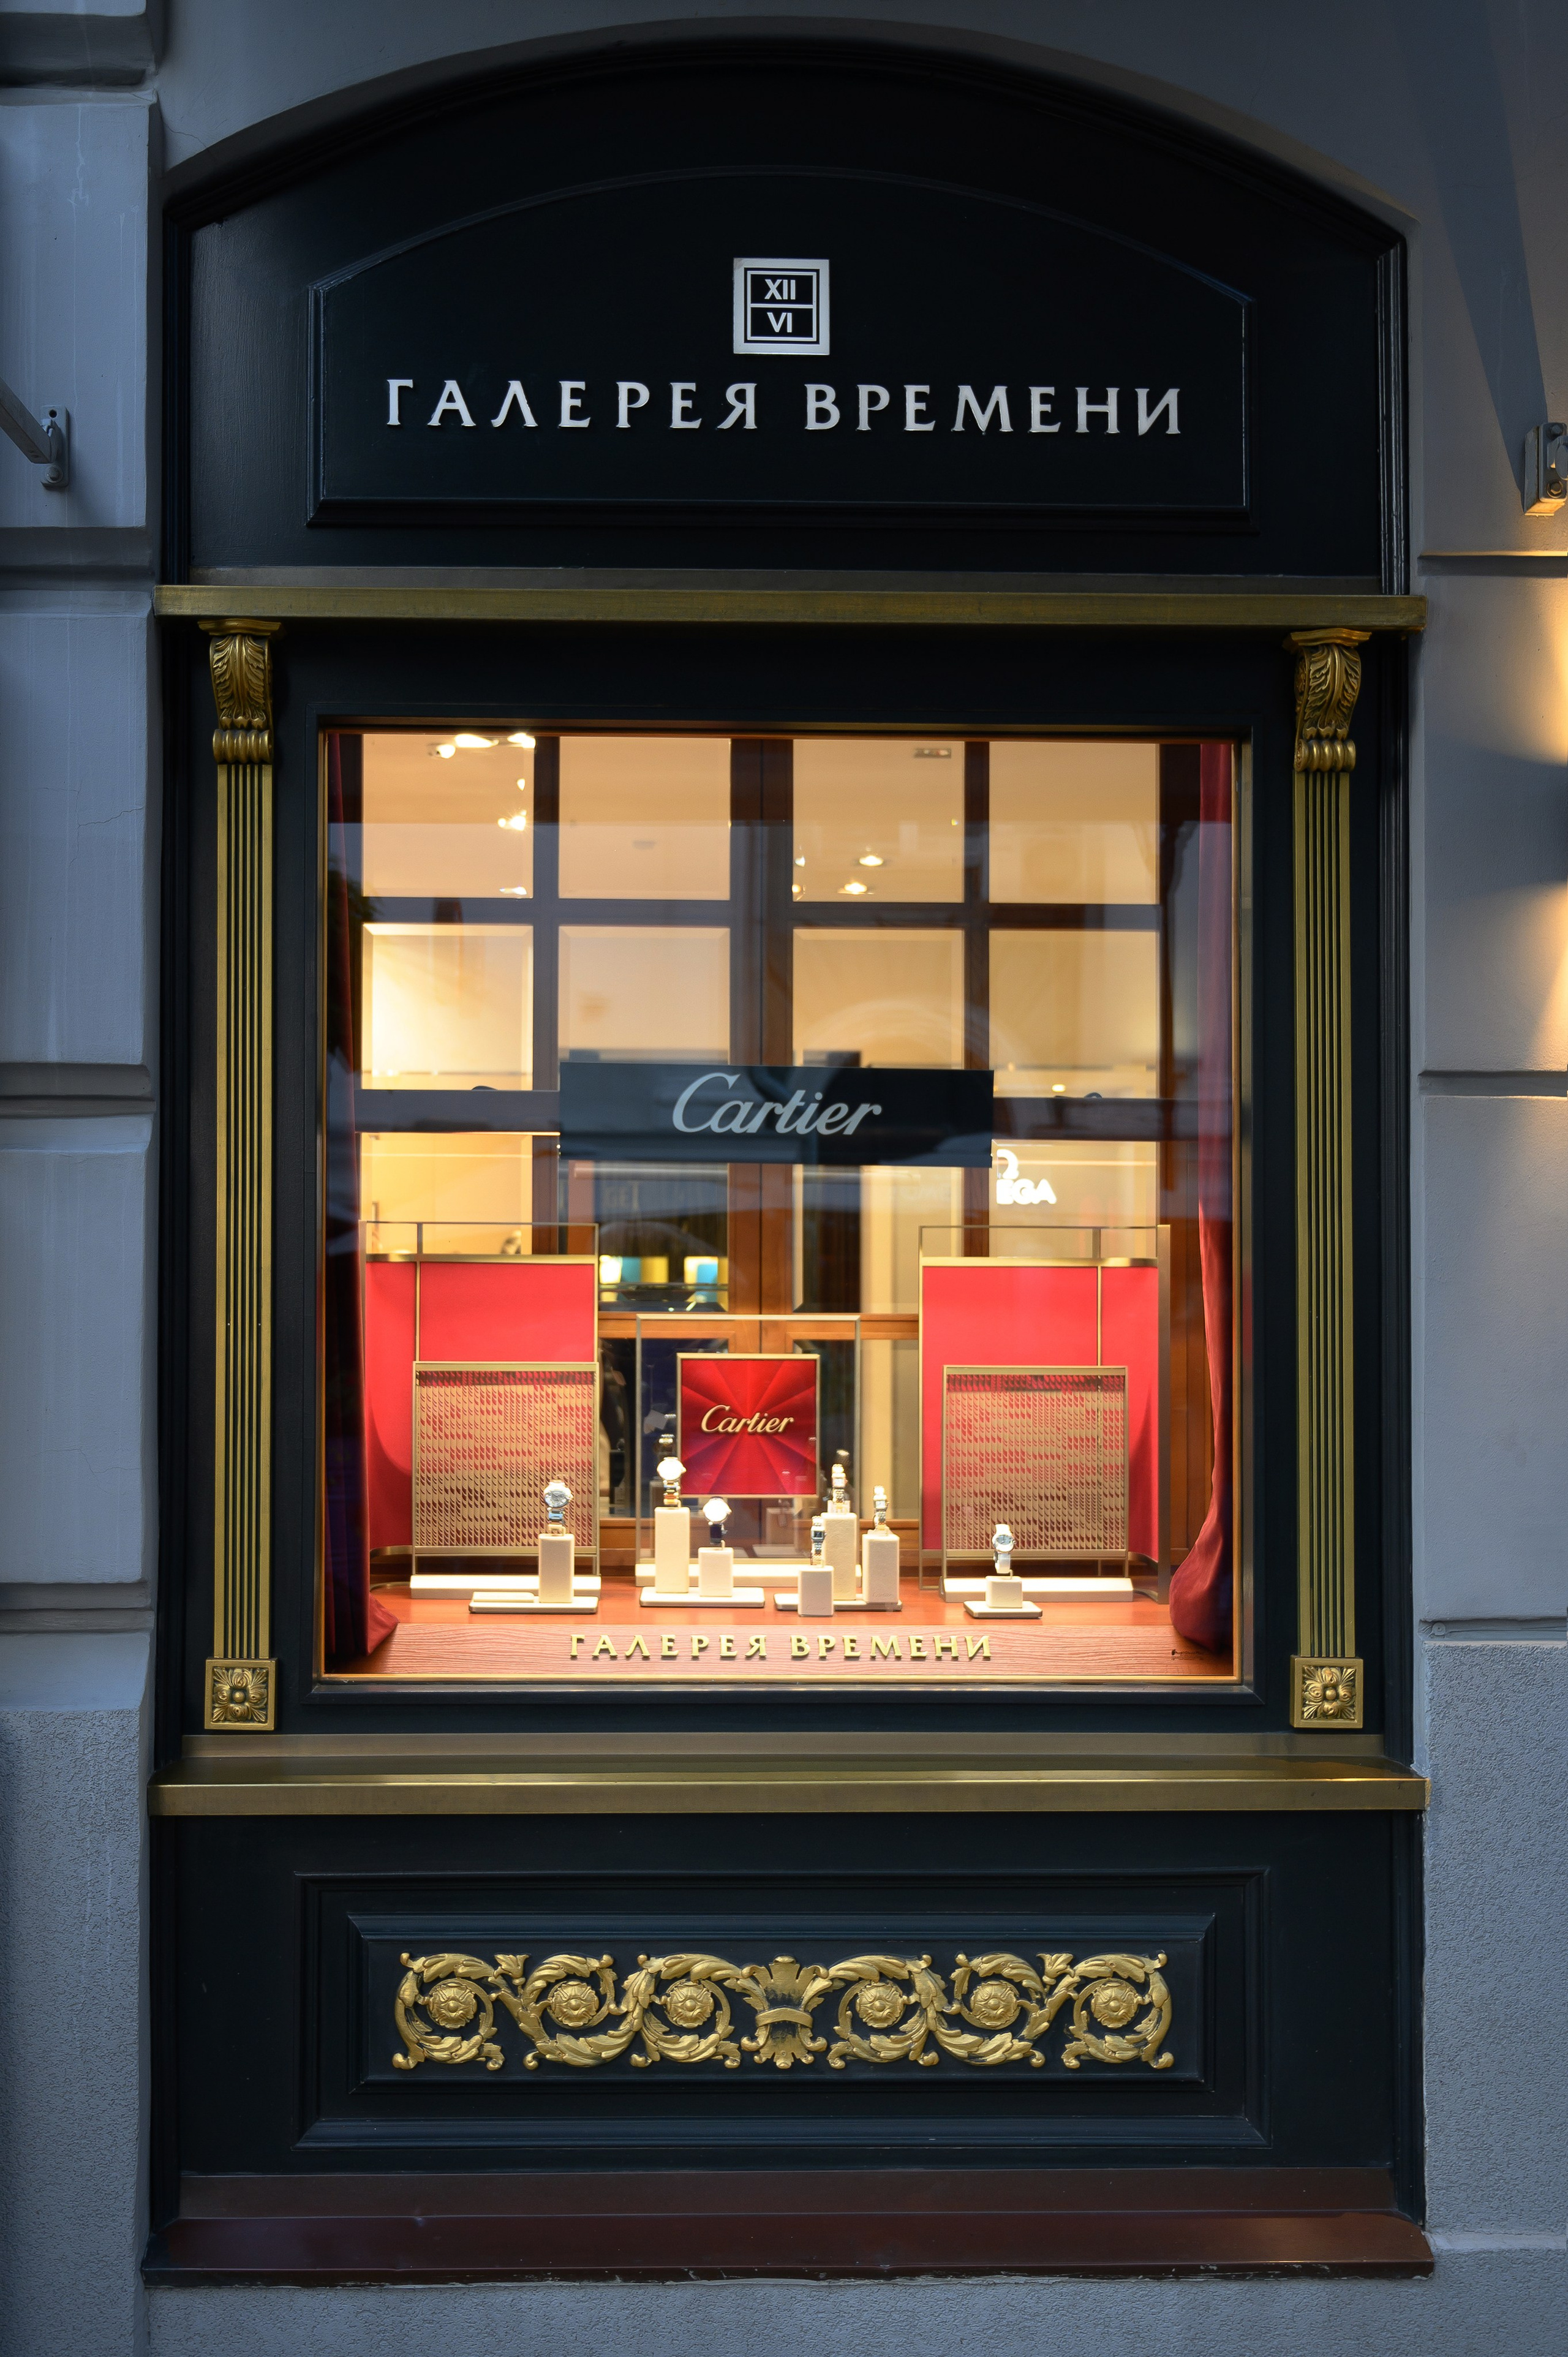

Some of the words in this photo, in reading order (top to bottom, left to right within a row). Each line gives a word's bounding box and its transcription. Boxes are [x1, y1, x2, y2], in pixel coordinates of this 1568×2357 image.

[764, 279, 796, 300] XII
[767, 312, 793, 333] VI
[386, 379, 758, 429] ГАЛЕРЕЯ
[805, 383, 1181, 435] ВРЕМЕНИ
[672, 1073, 882, 1136] Cartier
[701, 1405, 794, 1434] Cartier
[570, 1634, 767, 1658] ГАЛЕРЕЯ
[790, 1634, 992, 1659] ВРЕМЕНИ
